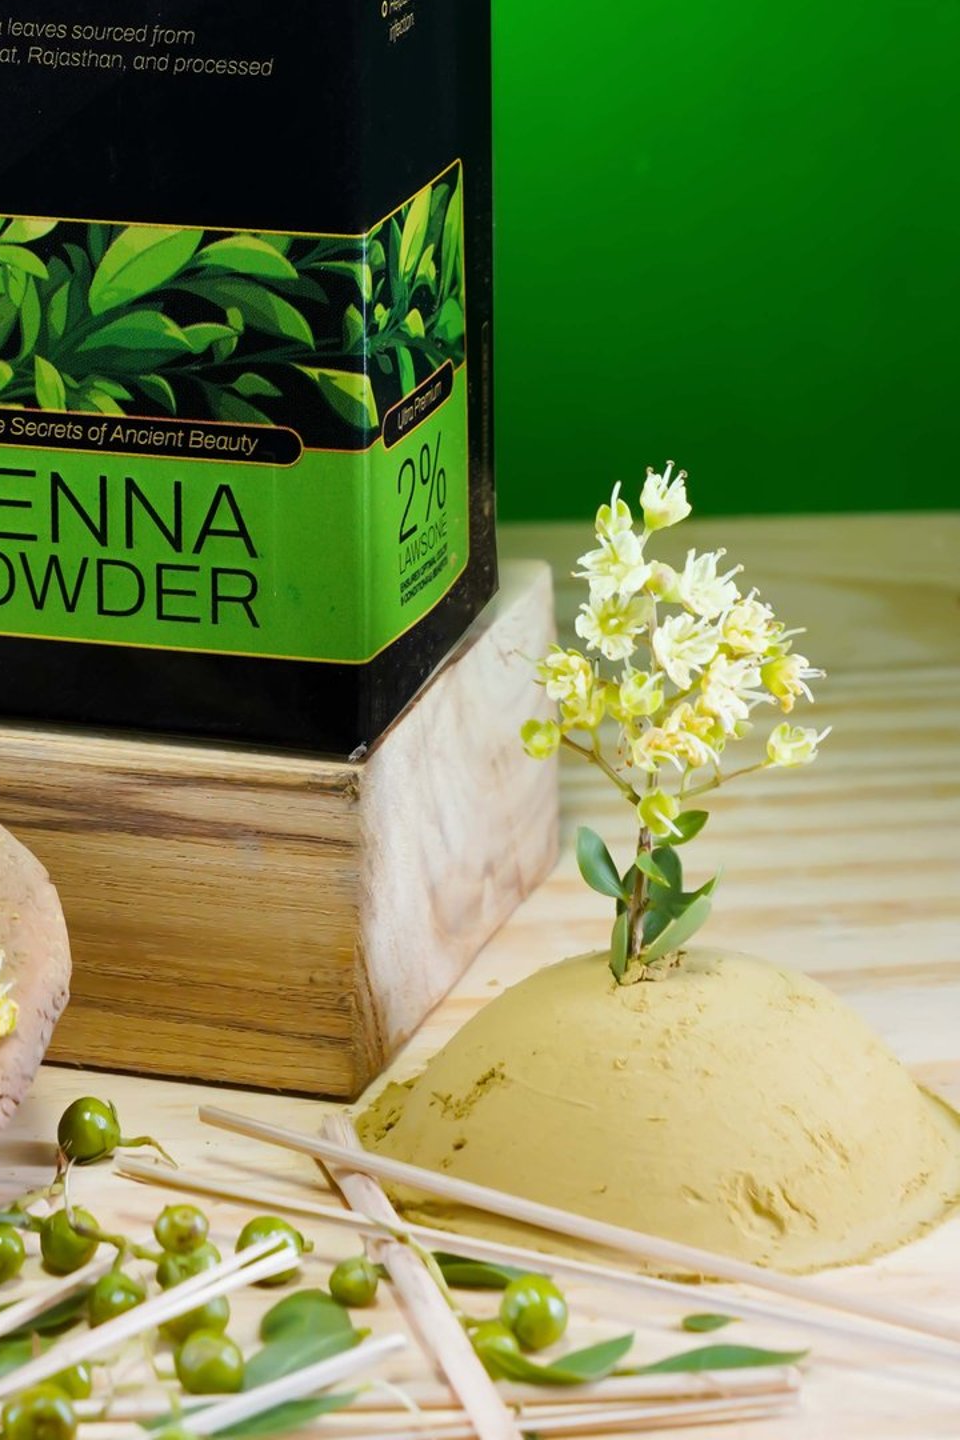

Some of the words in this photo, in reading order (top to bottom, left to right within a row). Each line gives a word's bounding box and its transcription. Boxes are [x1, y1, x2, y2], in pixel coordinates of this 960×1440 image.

[7, 18, 66, 39] leaves
[71, 22, 147, 43] sourced
[149, 25, 195, 47] from
[28, 46, 127, 72] Rajasthan,
[133, 52, 169, 71] and
[172, 56, 273, 79] processed
[10, 417, 83, 441] Secrets
[87, 423, 108, 446] of
[110, 424, 183, 447] Ancient
[188, 429, 259, 456] Beauty
[398, 431, 446, 544] 2%
[399, 512, 448, 575] LAWSONE
